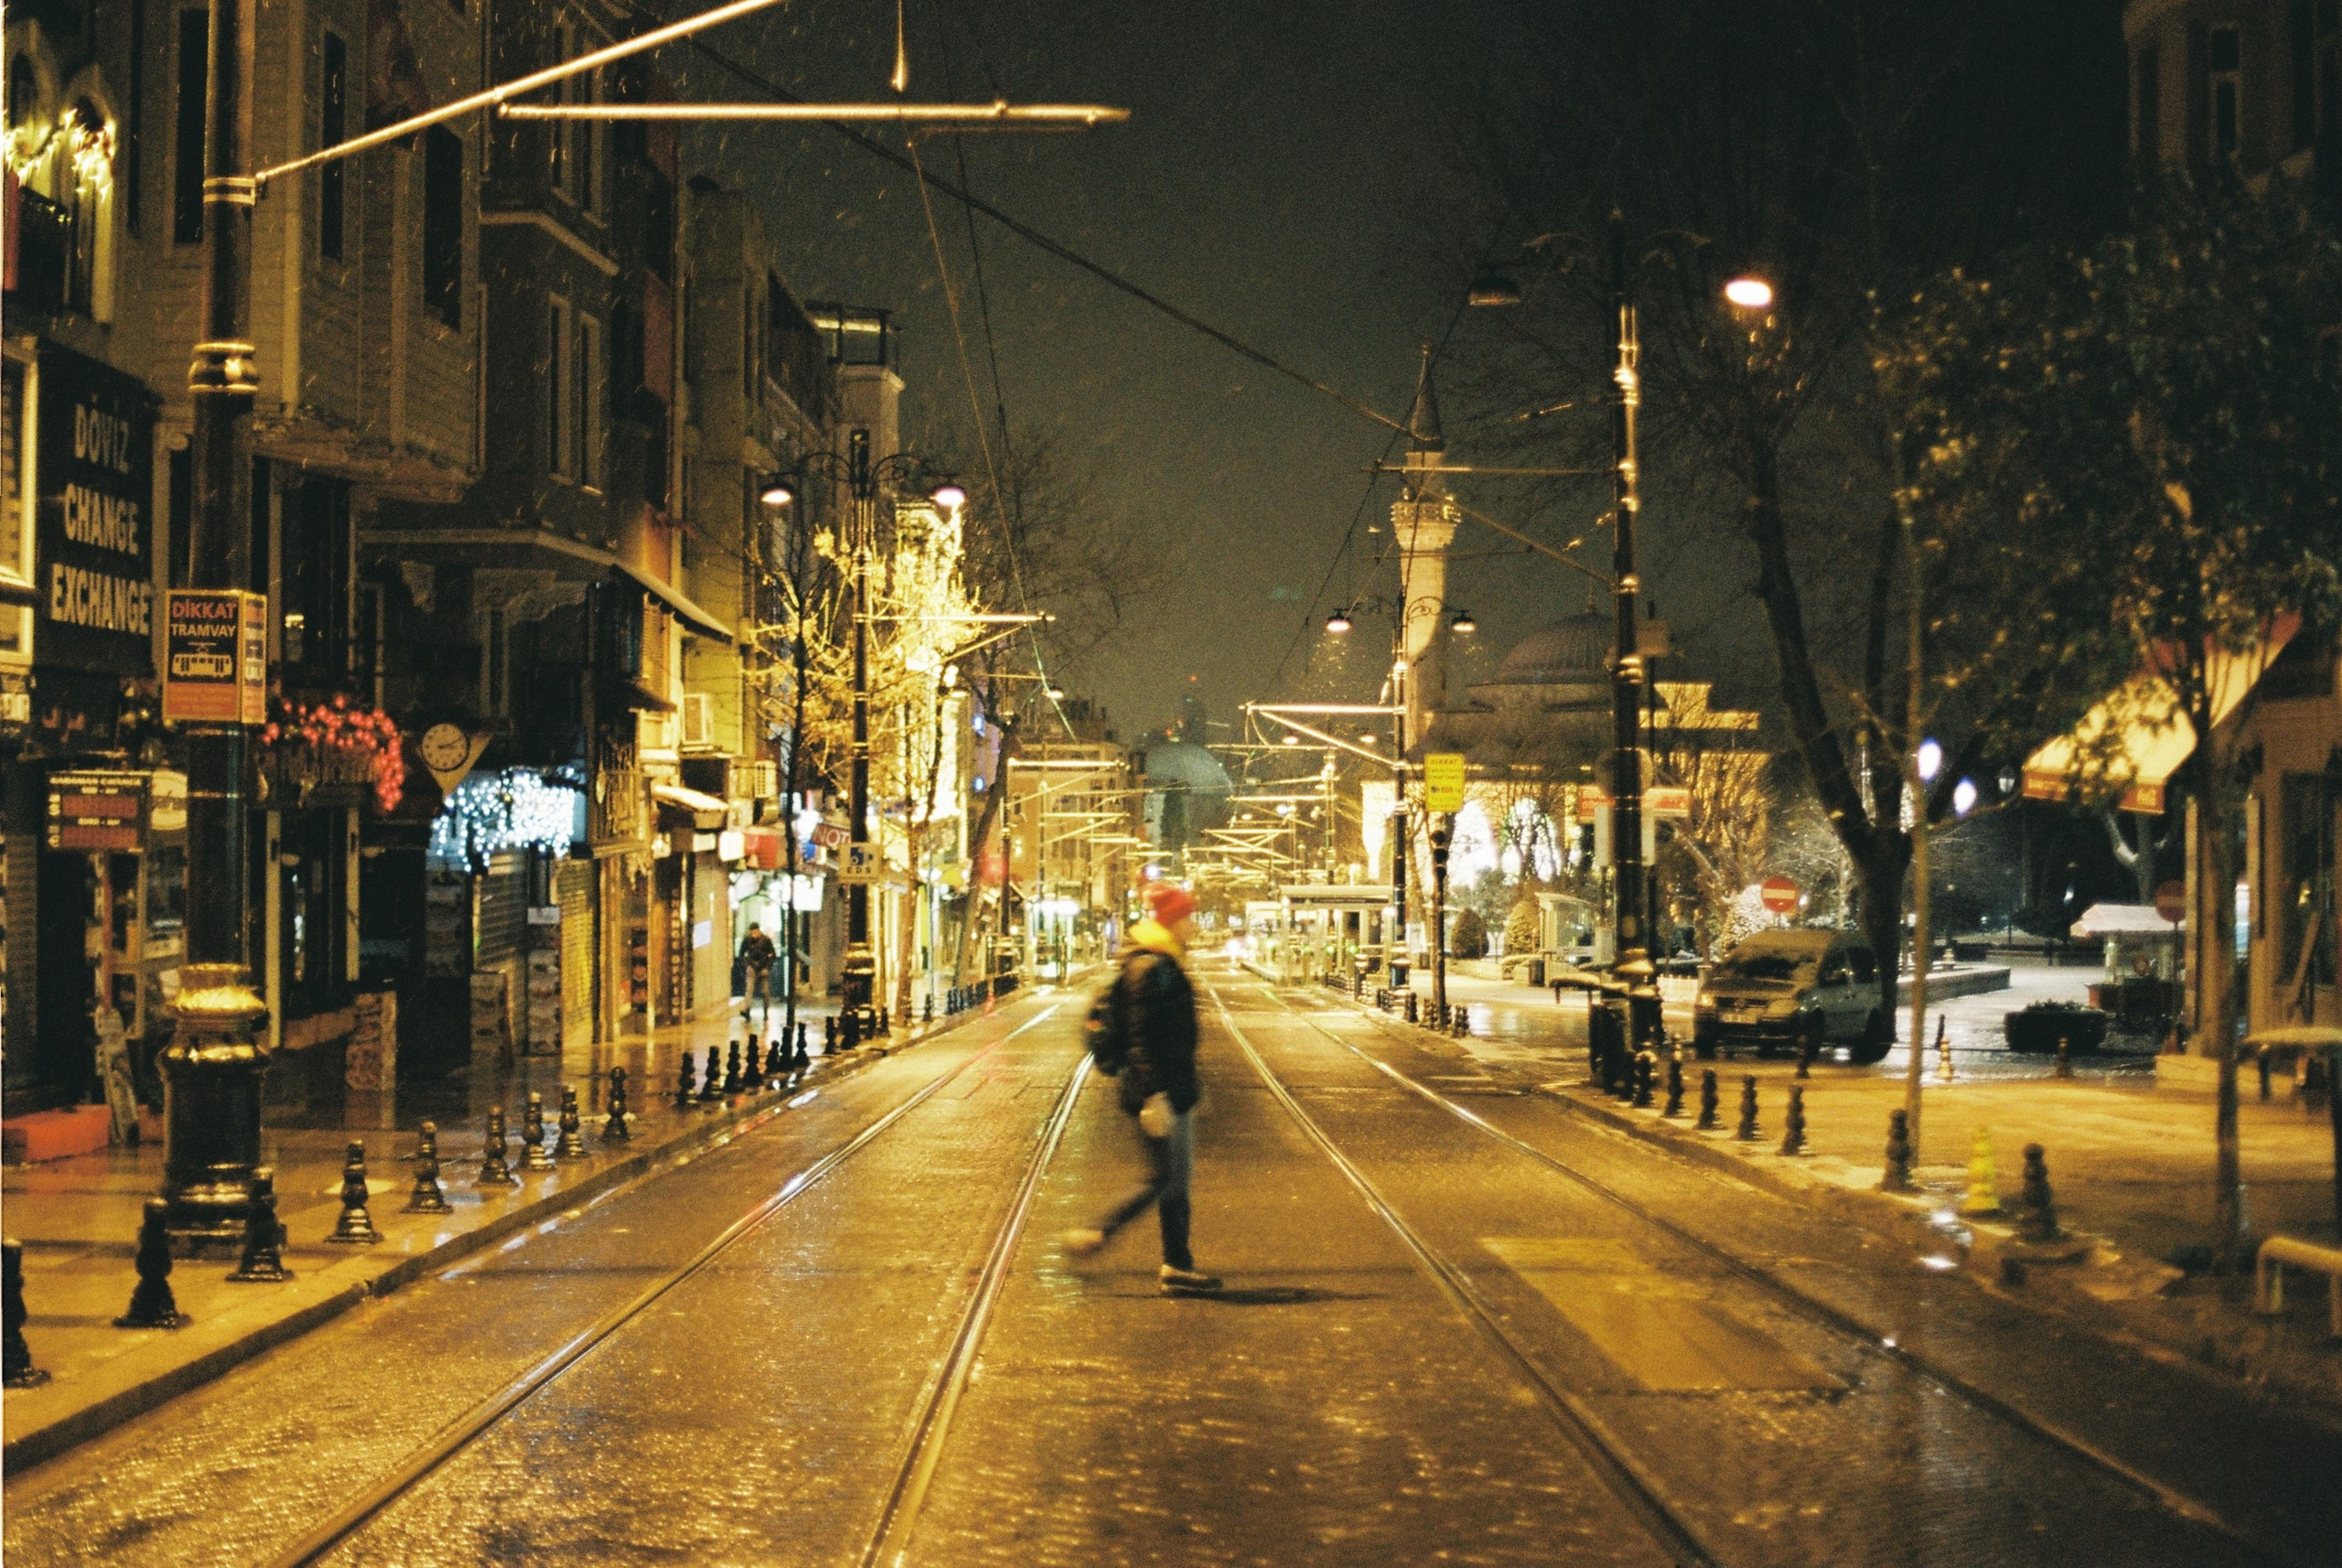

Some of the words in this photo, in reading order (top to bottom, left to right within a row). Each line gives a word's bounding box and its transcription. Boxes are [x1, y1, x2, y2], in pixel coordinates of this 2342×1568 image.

[64, 482, 138, 554] CHANGE
[50, 563, 150, 636] EXCHANGE
[172, 598, 237, 619] DİKKAT
[170, 623, 237, 639] TRAMVAY
[846, 865, 872, 875] EDS
